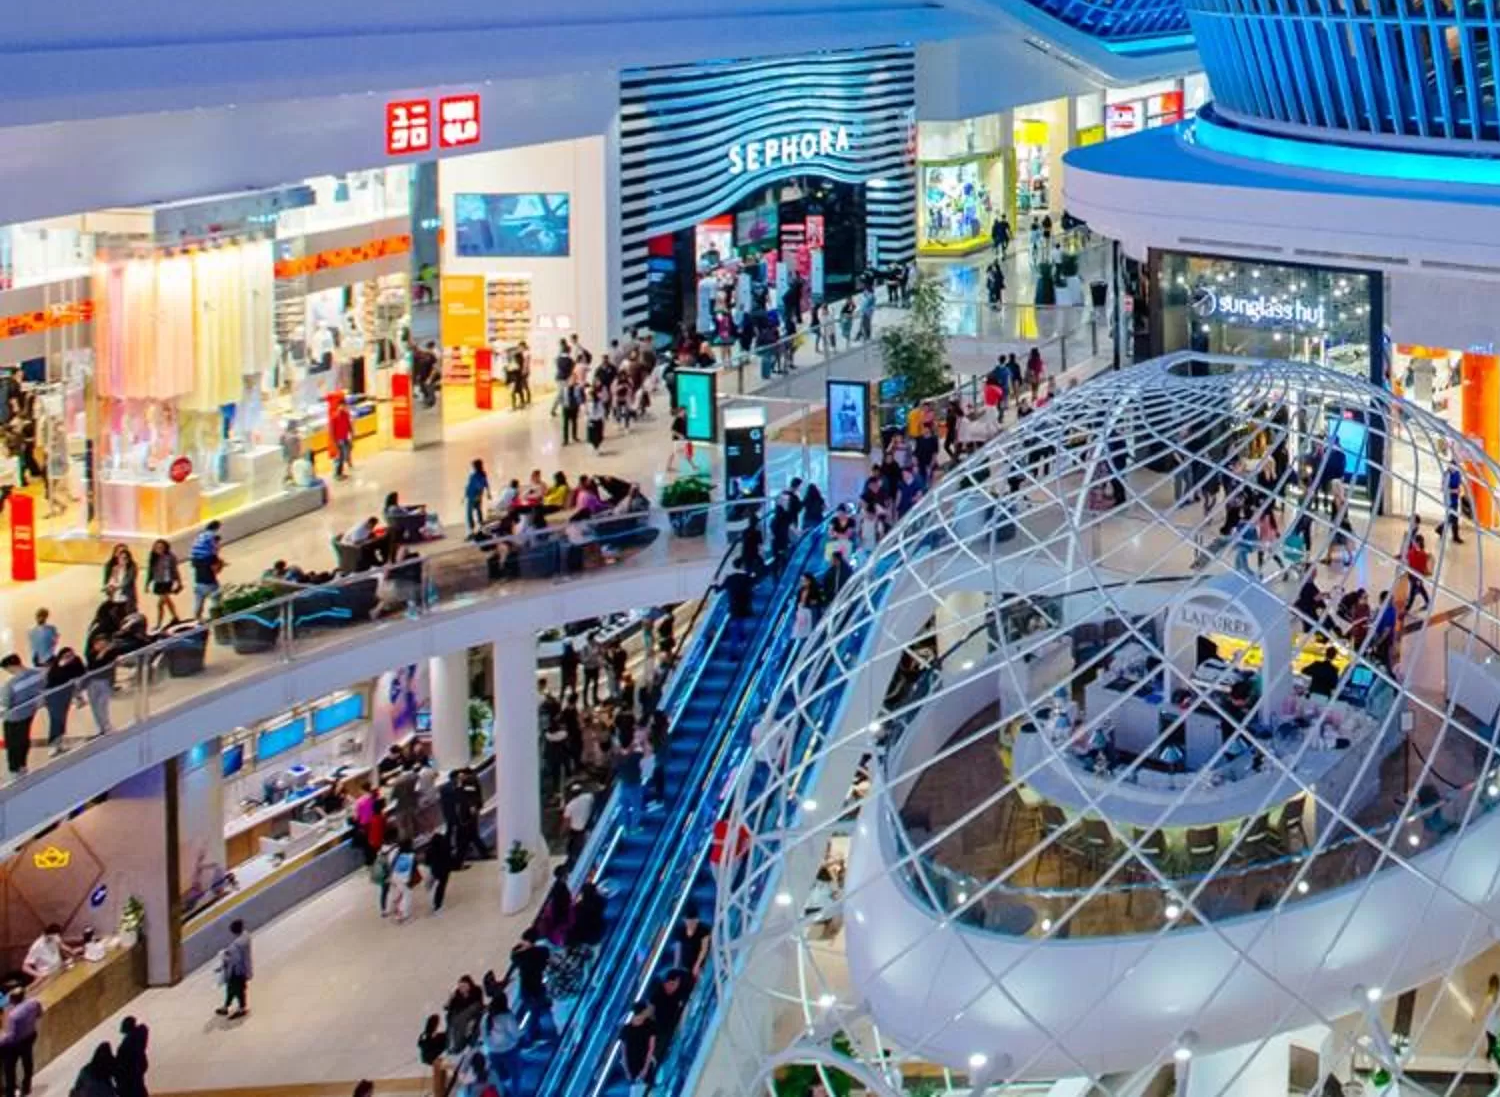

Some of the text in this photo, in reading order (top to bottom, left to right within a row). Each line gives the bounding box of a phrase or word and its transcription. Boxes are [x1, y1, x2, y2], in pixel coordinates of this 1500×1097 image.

[729, 125, 849, 175] SEPHORA
[1219, 296, 1325, 327] sunglass hut
